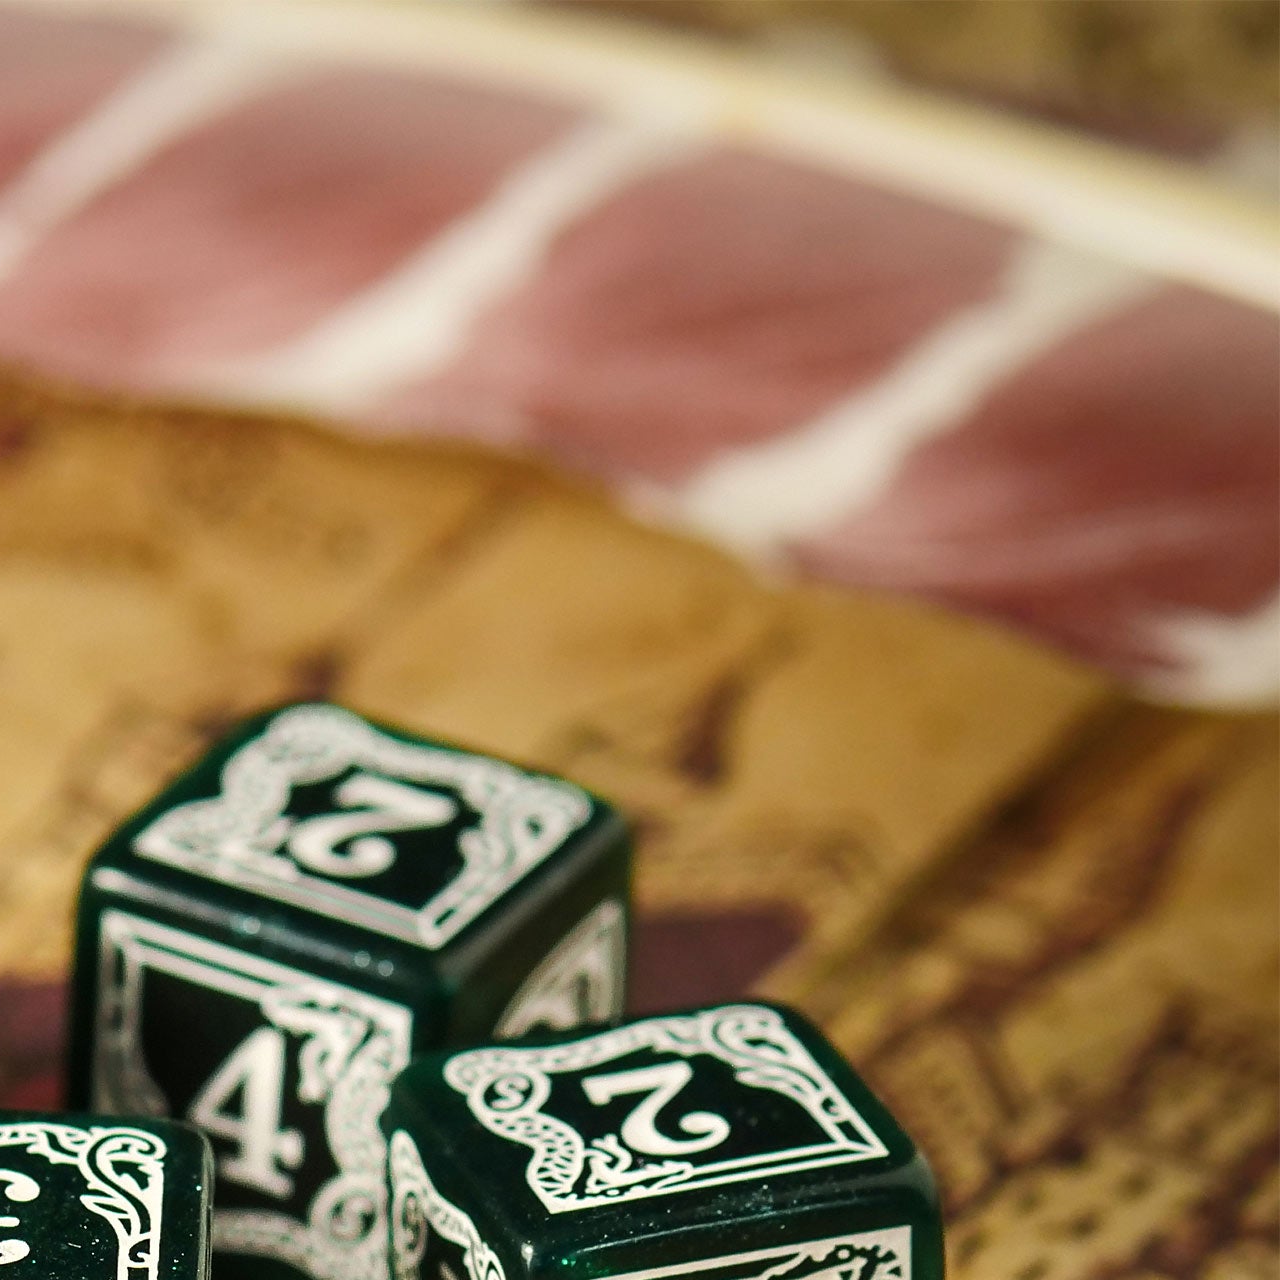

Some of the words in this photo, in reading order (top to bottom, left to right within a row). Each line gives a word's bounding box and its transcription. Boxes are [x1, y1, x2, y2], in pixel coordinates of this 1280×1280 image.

[286, 770, 457, 878] 2
[194, 1027, 303, 1195] 4
[582, 1060, 730, 1156] 2
